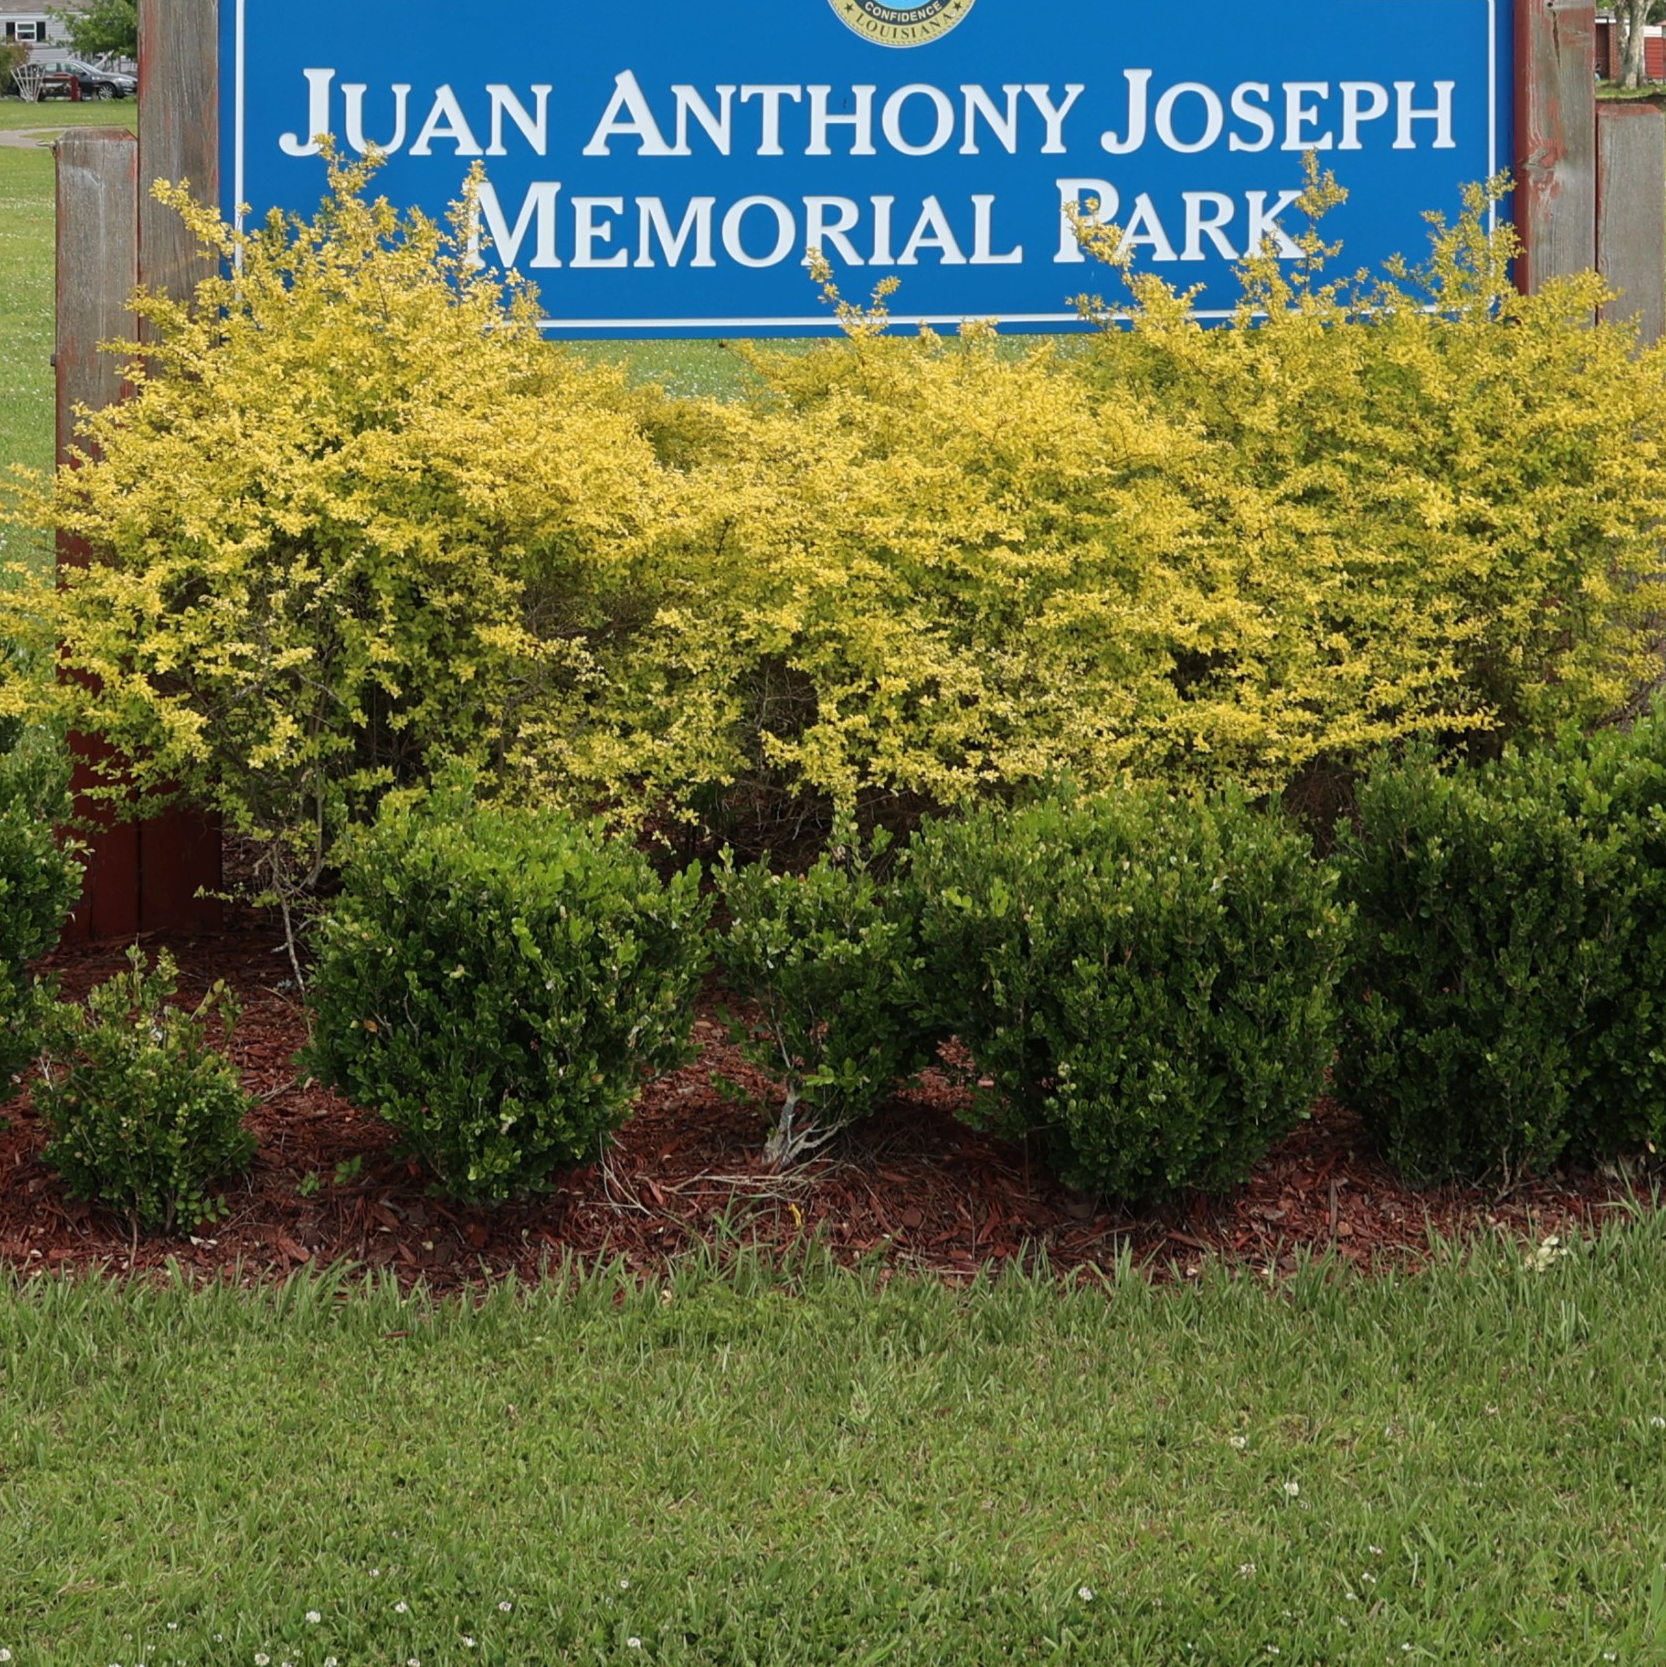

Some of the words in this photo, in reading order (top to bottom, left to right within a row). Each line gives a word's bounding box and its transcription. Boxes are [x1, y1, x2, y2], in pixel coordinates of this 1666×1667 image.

[855, 12, 954, 40] LOUISIANA
[864, 0, 943, 23] CONFIDENCE
[278, 67, 553, 157] JUAN
[582, 69, 1086, 157] ANTHONY
[1100, 67, 1456, 155] JOSEPH
[461, 180, 1023, 269] MEMORIAL
[1052, 177, 1308, 263] PARK
